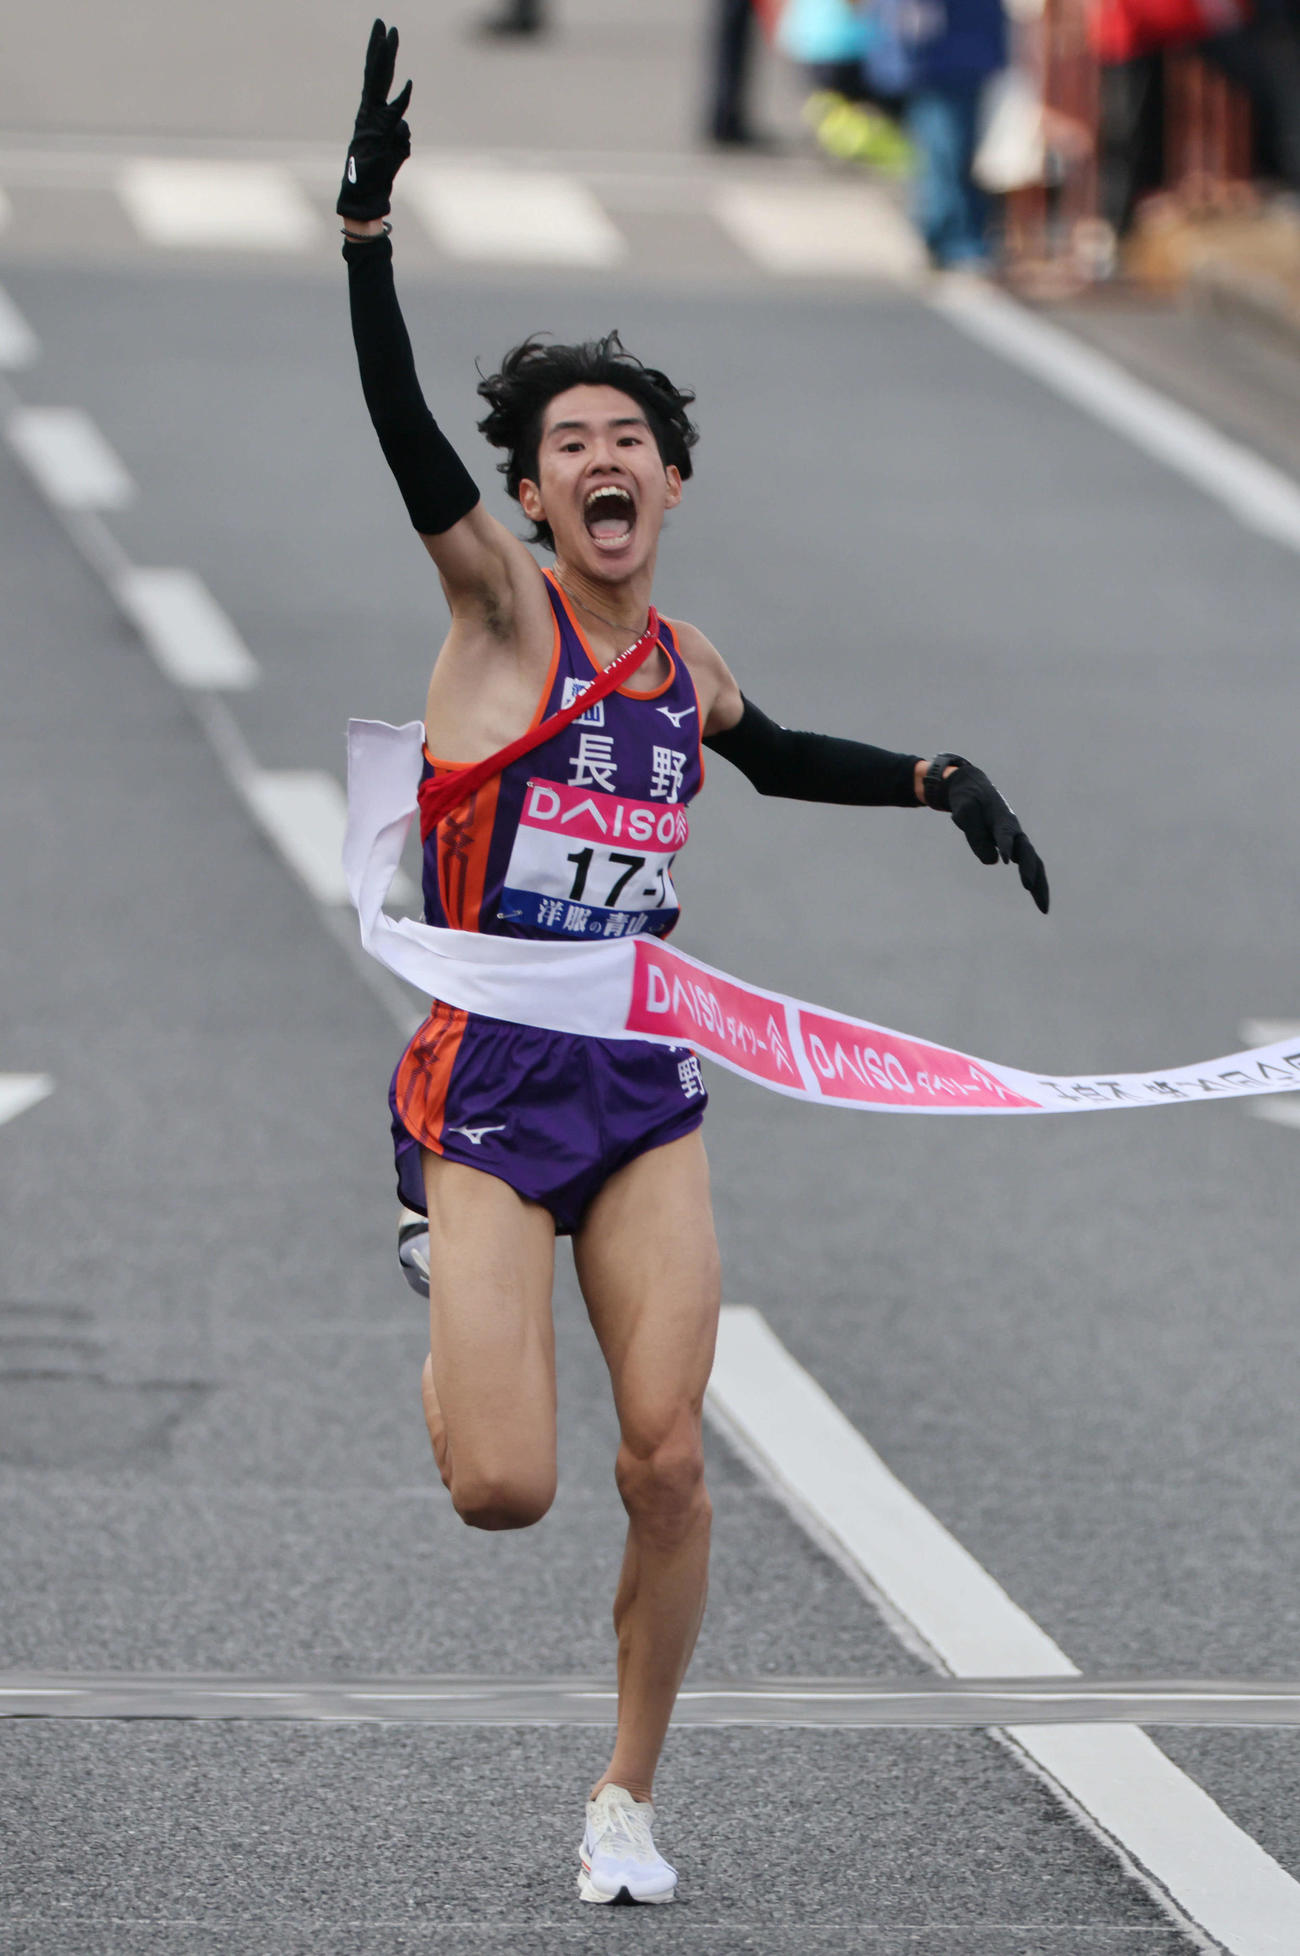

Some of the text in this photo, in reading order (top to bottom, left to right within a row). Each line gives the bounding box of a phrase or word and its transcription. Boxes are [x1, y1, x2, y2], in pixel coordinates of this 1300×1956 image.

[528, 785, 675, 844] DAISO
[537, 898, 648, 937] 洋服の青山
[646, 963, 725, 1040] DAISO
[673, 1050, 705, 1099] 野
[809, 1033, 915, 1094] DAISO
